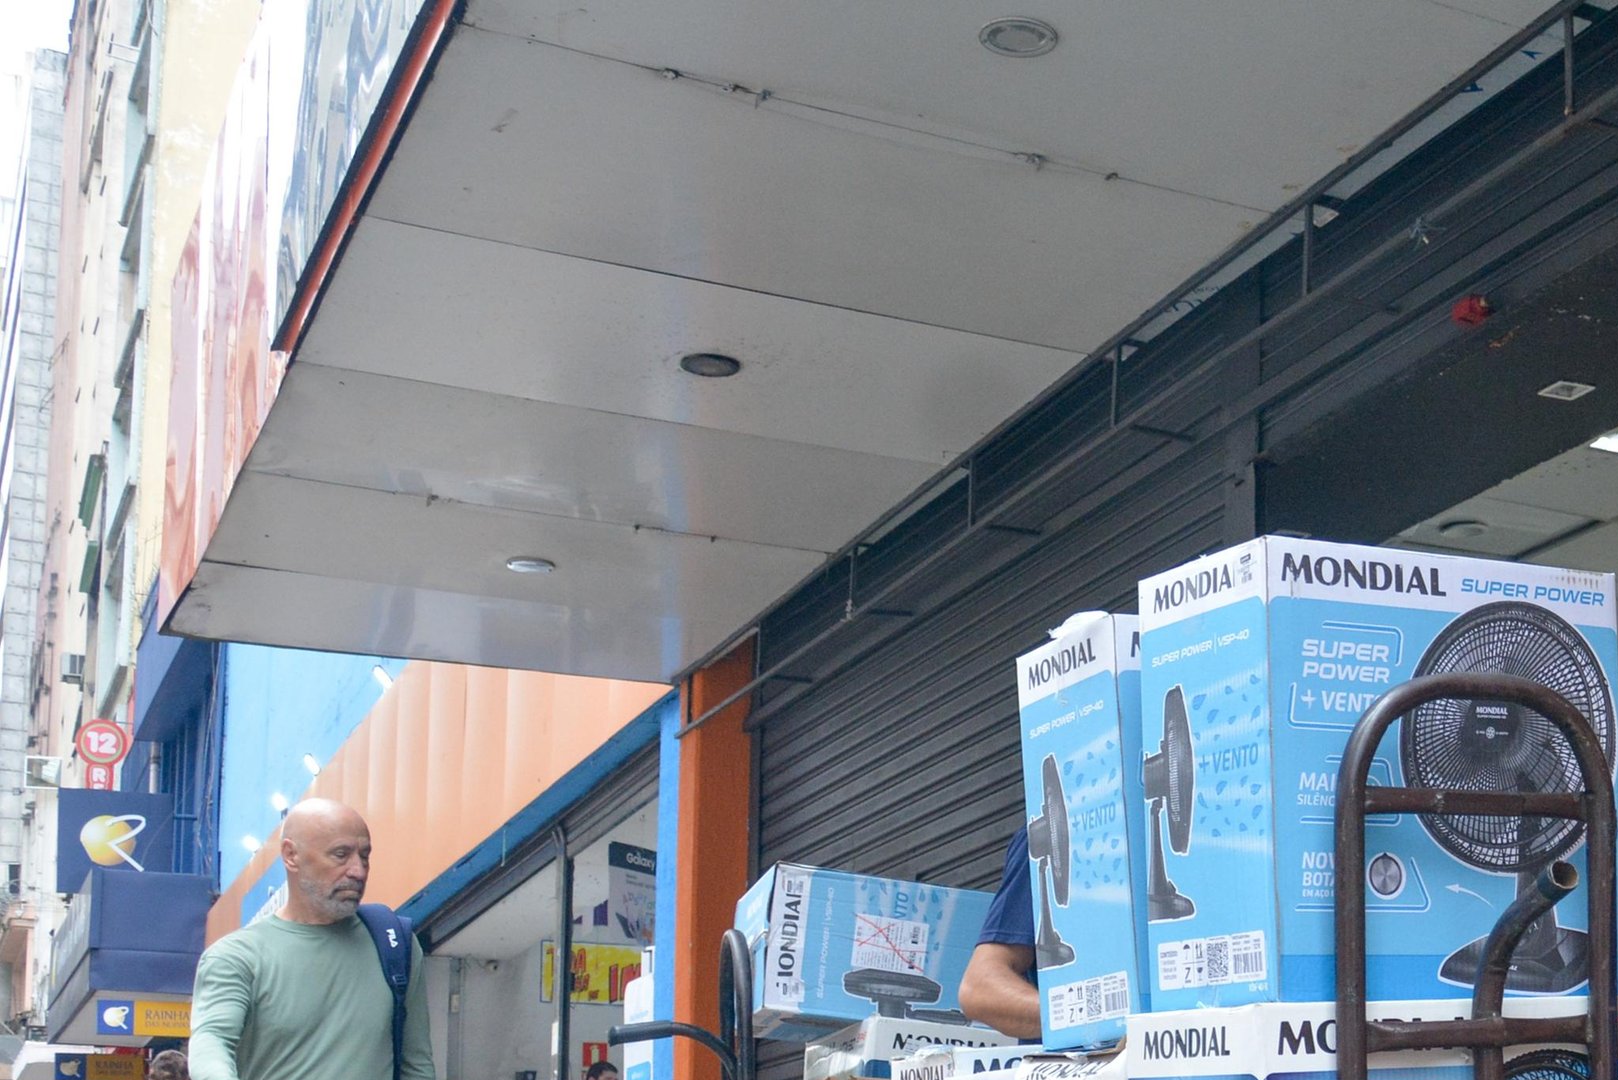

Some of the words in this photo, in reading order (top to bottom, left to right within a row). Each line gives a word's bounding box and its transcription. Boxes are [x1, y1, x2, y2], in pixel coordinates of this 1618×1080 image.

[1153, 563, 1236, 614] MONDIA
[1281, 552, 1447, 597] MONDIAL
[1461, 578, 1528, 599] SUPER
[1535, 586, 1604, 607] POWER
[1028, 637, 1096, 691] MONDIAL
[1152, 649, 1180, 668] SUPER
[1181, 639, 1213, 662] POWER
[1302, 637, 1390, 663] SUPER
[1303, 661, 1390, 684] POWER
[1322, 690, 1379, 713] VENT
[1475, 706, 1508, 715] MONDIAL
[86, 730, 117, 755] 12
[1212, 742, 1259, 772] VENTO
[1081, 800, 1116, 832] VENTO
[145, 1009, 190, 1021] RAINHA
[1143, 1025, 1231, 1061] MONDIAL
